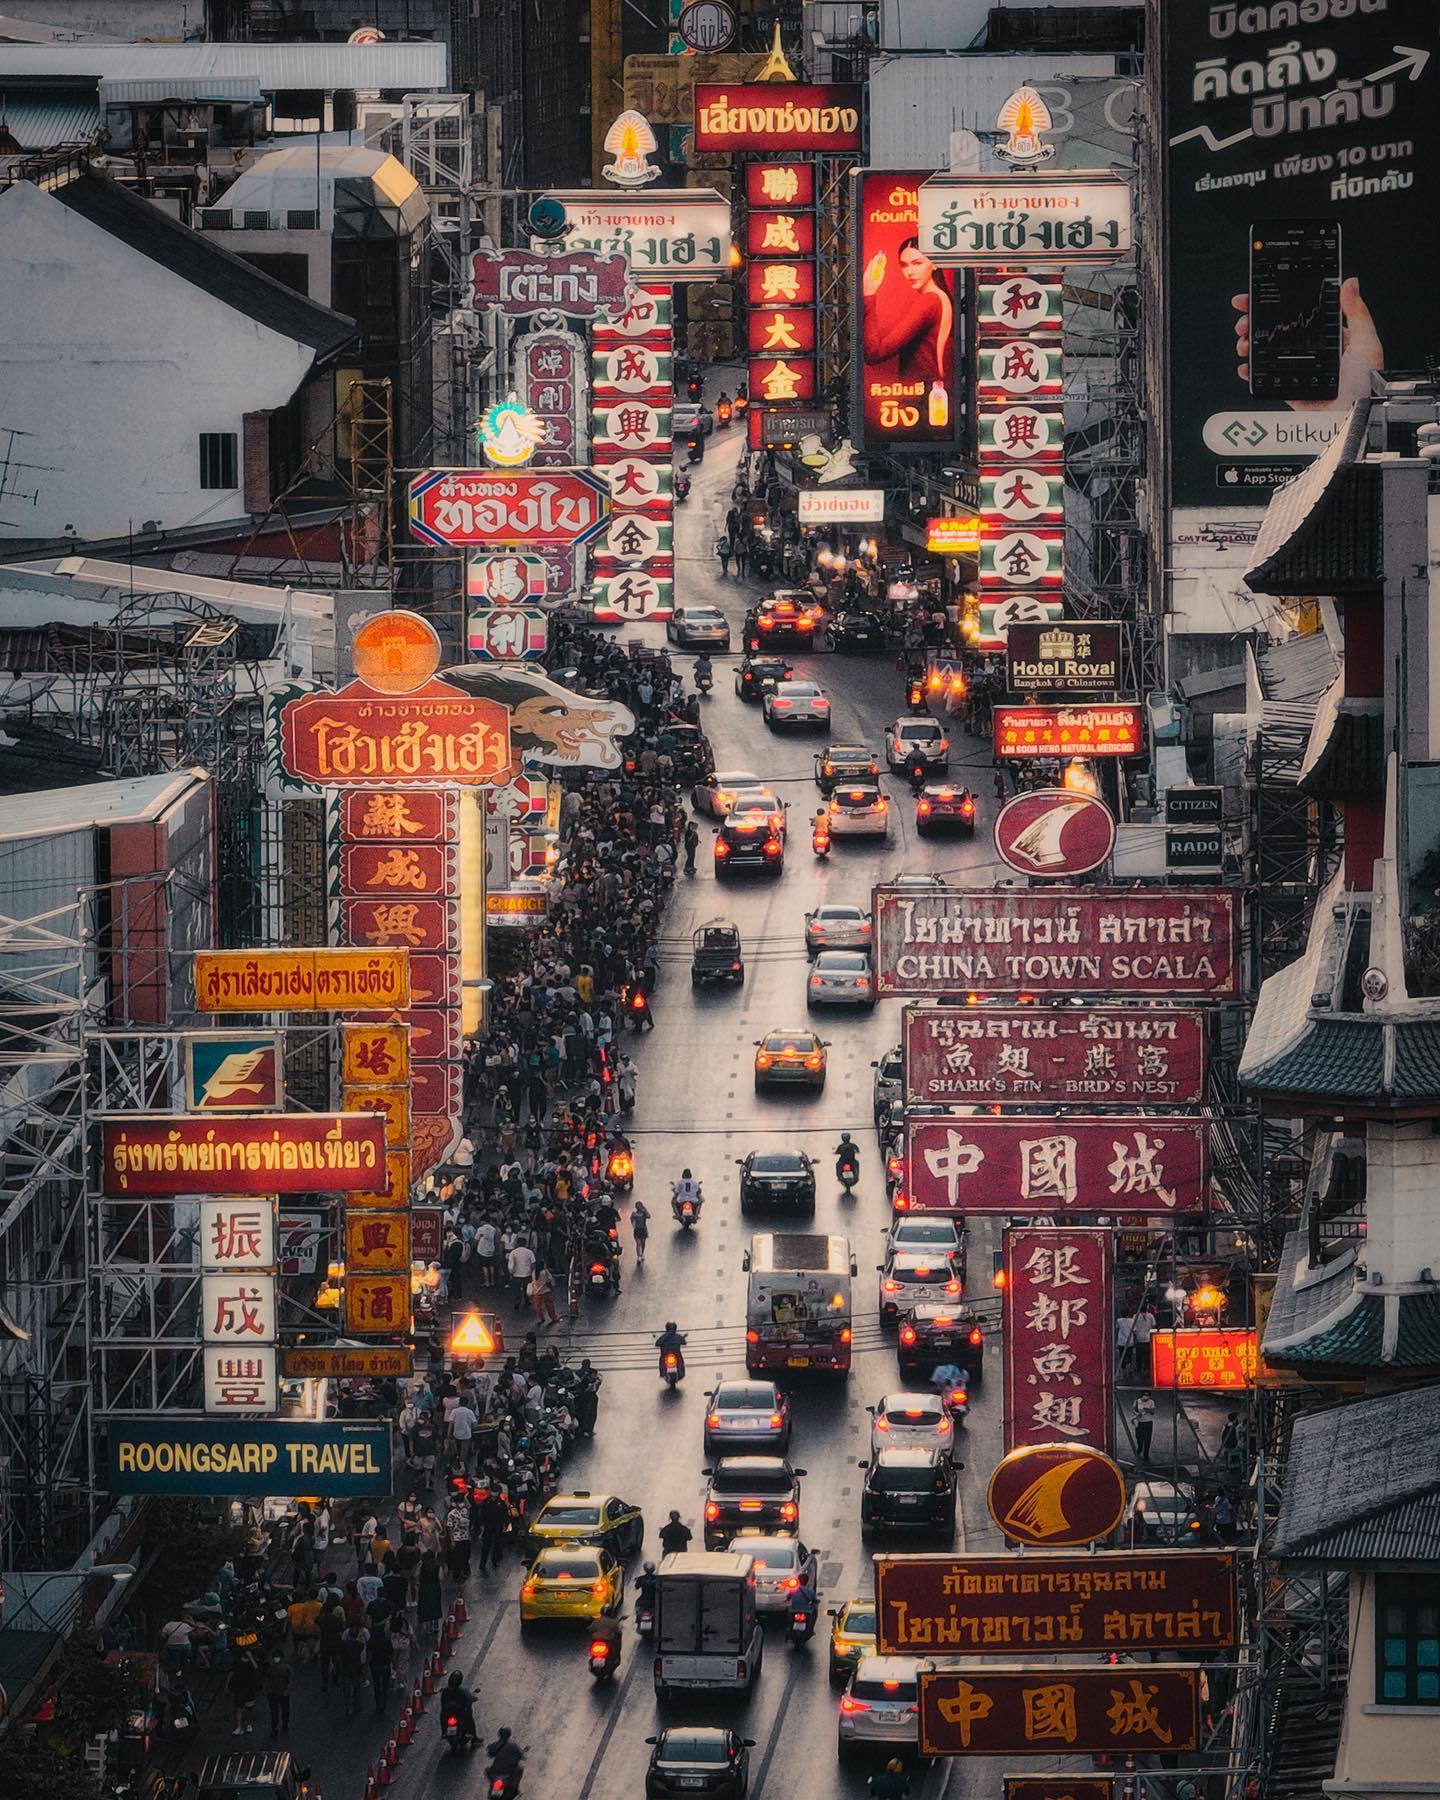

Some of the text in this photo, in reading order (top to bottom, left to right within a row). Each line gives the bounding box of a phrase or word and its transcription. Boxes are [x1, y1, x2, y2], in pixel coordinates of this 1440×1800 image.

[1192, 41, 1337, 102] คิดถึง
[1251, 79, 1396, 138] บิทคับ
[1273, 153, 1334, 178] เพียง
[1337, 147, 1366, 167] 10
[1370, 140, 1413, 161] บาท
[880, 402, 920, 428] ขิง
[1244, 474, 1266, 485] App
[433, 481, 592, 534] ทองใบ
[1178, 534, 1209, 542] CMYK
[1013, 661, 1115, 678] Hotel Royal
[1014, 679, 1052, 689] Bangkok
[1067, 679, 1115, 688] Chinatown
[1170, 800, 1218, 810] CITIZEN
[1170, 841, 1219, 852] RADO
[896, 955, 1216, 979] CHINA TOWN SCALA
[928, 1078, 1006, 1093] SHARK'S
[1013, 1079, 1042, 1093] FIN
[1066, 1079, 1124, 1093] BIRD'S
[1132, 1080, 1180, 1093] NEST
[923, 1128, 1177, 1207] 中國城
[119, 1443, 381, 1473] ROONGSARP TRAVEL
[937, 1680, 1173, 1748] 中國城
